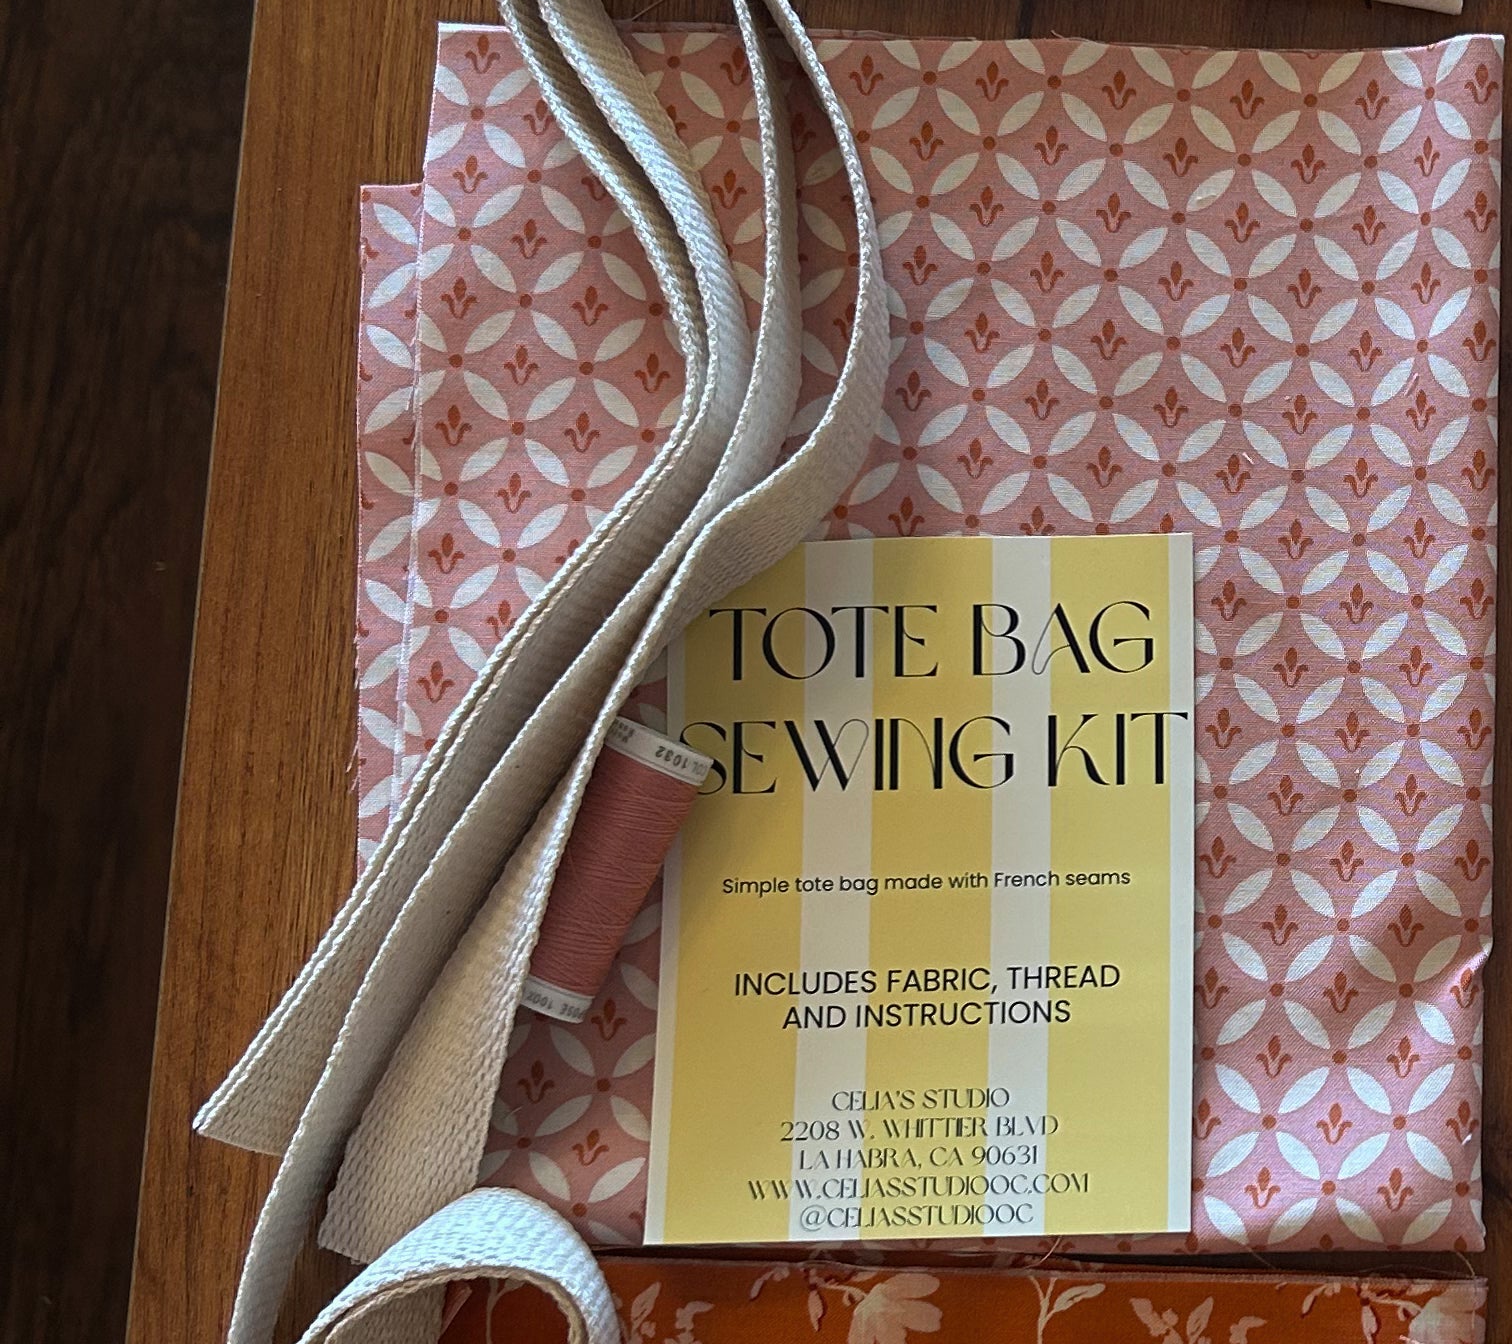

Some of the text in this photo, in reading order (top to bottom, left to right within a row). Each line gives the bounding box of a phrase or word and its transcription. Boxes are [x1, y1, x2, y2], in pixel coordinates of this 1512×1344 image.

[708, 600, 1154, 681] TOTE BAG
[654, 744, 689, 770] 1032
[679, 711, 1189, 796] SEWING KIT
[722, 870, 1131, 899] Simple tote bag made with French seams
[735, 964, 1121, 997] INCLUDES FABRIC, THREAD
[782, 999, 1071, 1030] AND INSTRUCTIONS
[831, 1087, 1010, 1112] CELIA'S STUDIO
[780, 1115, 1059, 1142] 2208 W. WHITTIER BLVD
[799, 1144, 1038, 1171] LA HABRA, CA 90631
[748, 1172, 1089, 1201] WWW.CELIASSTUDIOOC.COM
[799, 1202, 1034, 1233] @CELIASSTUDIOOC
